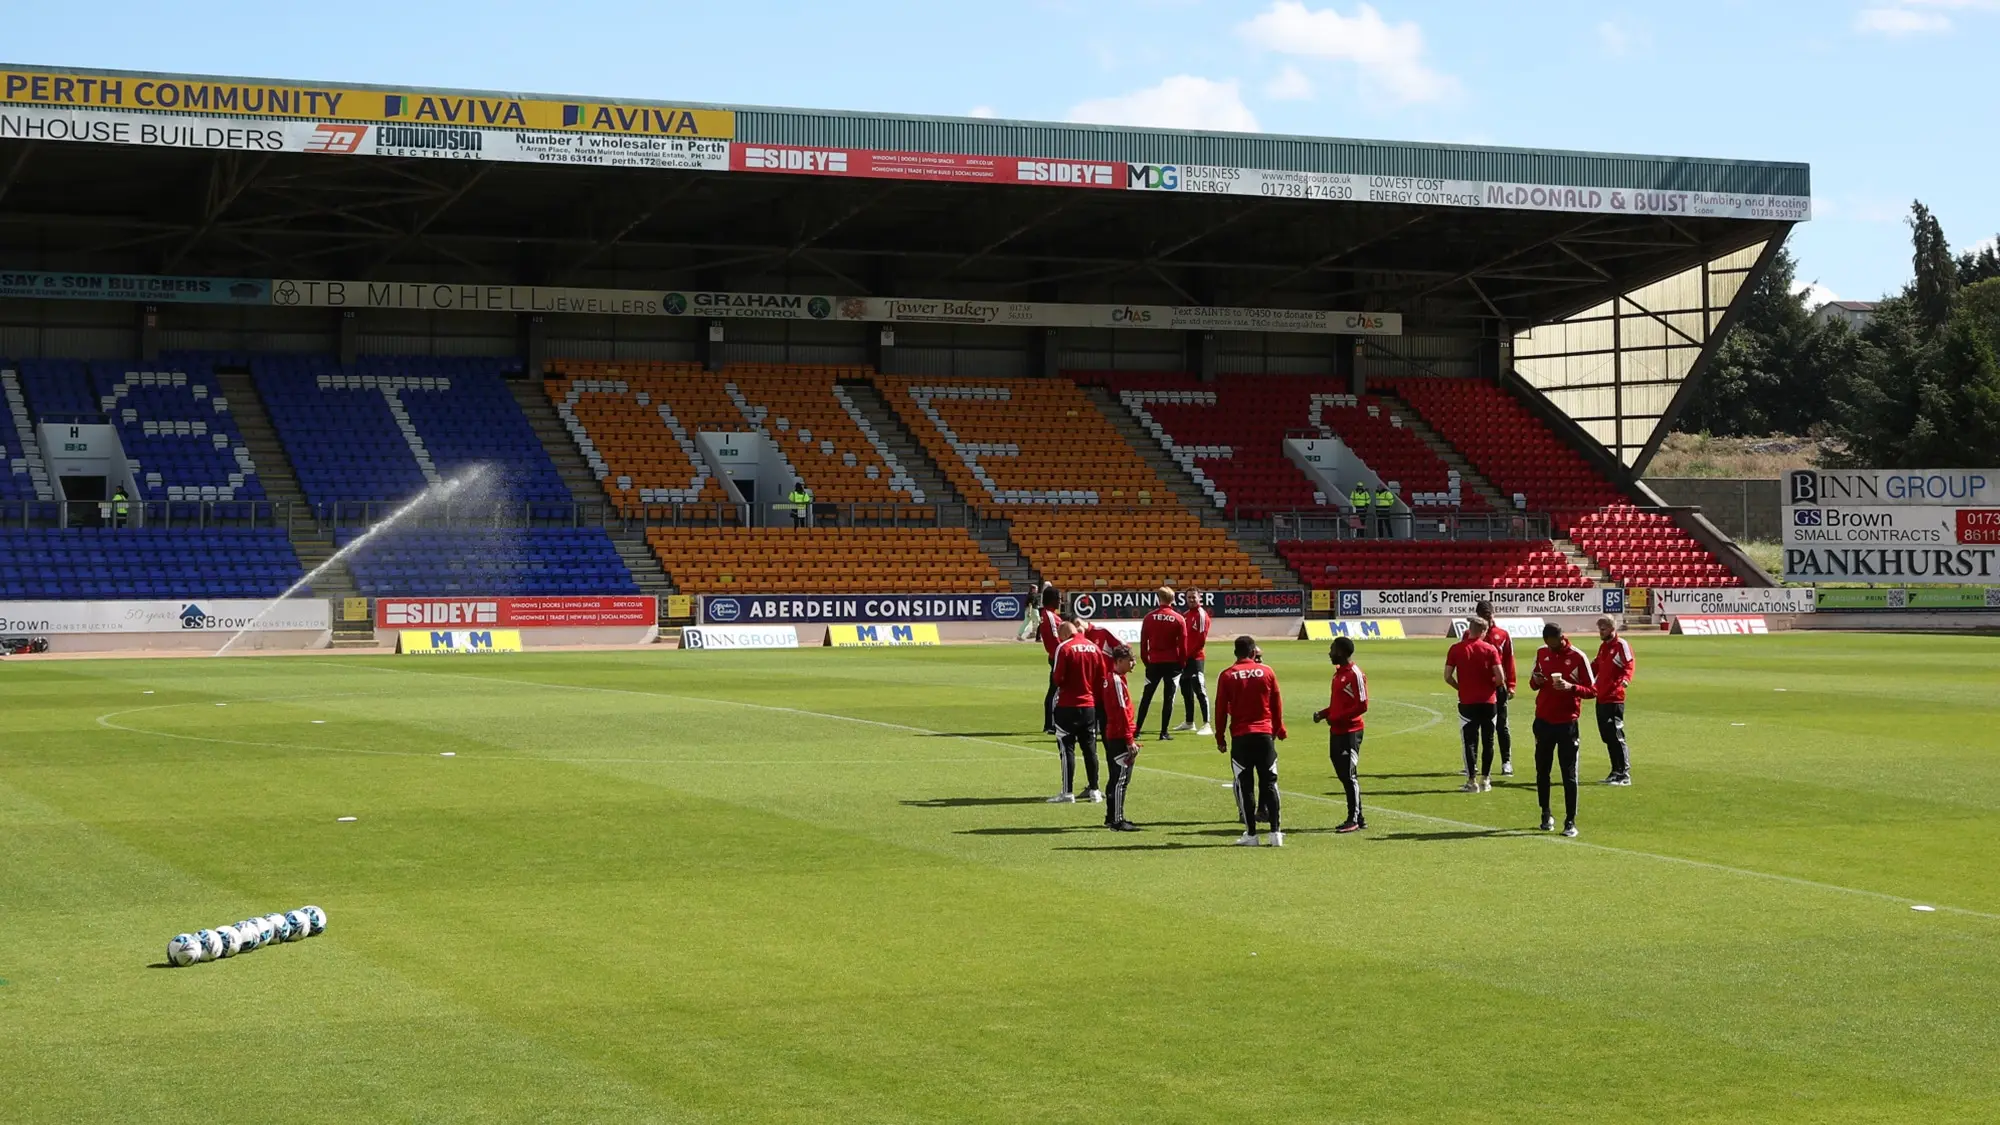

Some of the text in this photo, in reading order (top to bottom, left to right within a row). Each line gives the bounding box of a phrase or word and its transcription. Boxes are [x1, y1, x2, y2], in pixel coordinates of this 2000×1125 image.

[6, 75, 343, 115] PERTH COMMUNITY
[415, 97, 526, 125] AVIVA
[592, 107, 699, 134] AVIVA
[141, 123, 284, 150] BUILDERS
[516, 133, 725, 153] Number 1 wholesaler in Perth
[376, 147, 482, 160] ELECTRICAL
[539, 153, 568, 162] 01738
[570, 155, 604, 164] 631411
[627, 150, 660, 158] Industrial
[765, 149, 829, 171] SIDEY
[1035, 162, 1096, 184] SIDEY
[1127, 165, 1178, 190] MDG
[1185, 166, 1240, 181] BUSINESS
[1185, 179, 1231, 193] ENERGY
[1261, 182, 1352, 199] 01738 474630
[1369, 176, 1445, 190] LOWEST COST
[1369, 188, 1480, 206] ENERGY CONTRACTS
[1487, 185, 1688, 213] McDONALD & BUIST
[1693, 193, 1808, 212] Plumbing and Heating
[1751, 208, 1774, 217] 01738
[62, 275, 102, 289] SON
[108, 276, 212, 292] BUTCHERS
[302, 281, 545, 310] TB MITCHELL
[693, 293, 802, 309] GRAHAM
[547, 298, 657, 314] JEWELLERS
[694, 307, 800, 318] PEST CONTROL
[884, 300, 938, 319] Tower
[943, 301, 1000, 321] Bakery
[1173, 307, 1193, 316] Text
[1194, 307, 1230, 317] SAINTS
[1243, 308, 1271, 318] 70450
[1284, 310, 1313, 319] donate
[70, 426, 79, 438] H
[1307, 441, 1314, 451] J
[1793, 474, 1986, 499] BINN GROUP
[1794, 510, 1892, 526] GS Brown
[1967, 513, 2000, 525] 0173
[1794, 529, 1941, 541] SMALL CONTRACTS
[1785, 549, 1995, 576] PANKHURST
[1224, 594, 1258, 606] 01738
[1342, 593, 1358, 609] gs
[1378, 590, 1584, 604] Scotland's Premier Insurance Broker
[1605, 591, 1620, 607] gs
[1664, 589, 1723, 602] Hurricane
[407, 602, 477, 624] SIDEY
[749, 600, 861, 618] ABERDEIN
[865, 599, 983, 617] CONSIDINE
[1362, 606, 1406, 614] INSURANCE
[1407, 606, 1442, 614] BROKING
[1701, 602, 1796, 613] COMMUNICATIONS
[0, 617, 124, 631] Brown CONSTRUCTION
[182, 615, 204, 628] GS
[1152, 613, 1176, 623] TEXO
[1692, 618, 1751, 634] SIDEY
[430, 631, 493, 650] MKM
[686, 629, 797, 648] BINN GROUP
[1071, 644, 1096, 653] TEXO
[1231, 668, 1264, 680] TEXO
